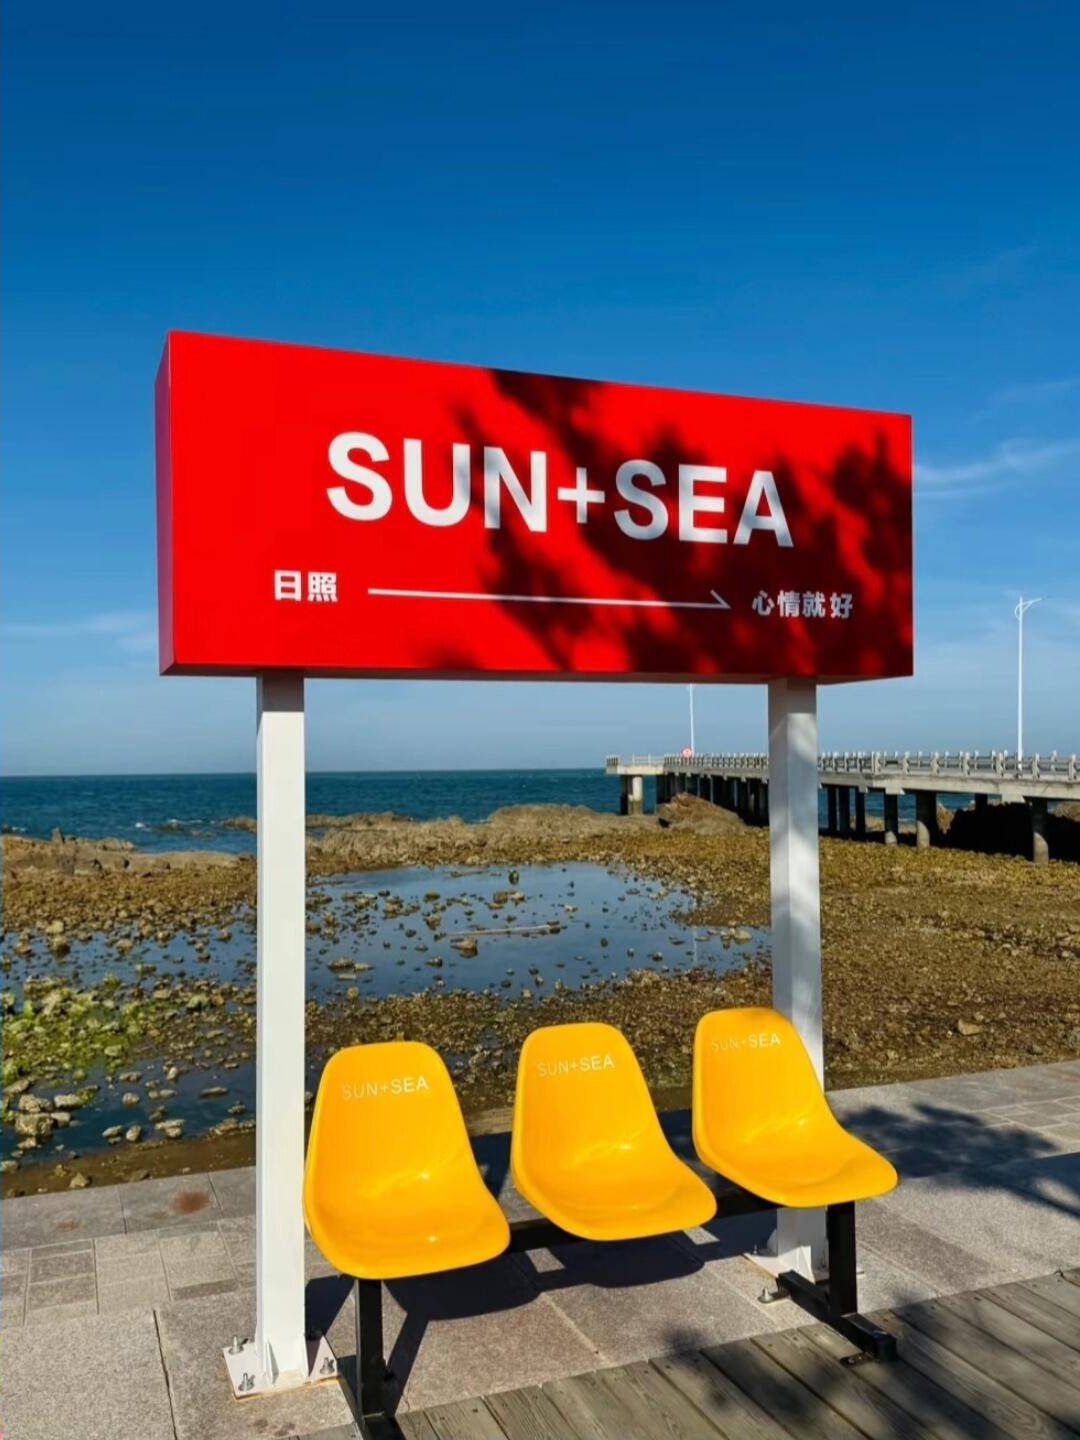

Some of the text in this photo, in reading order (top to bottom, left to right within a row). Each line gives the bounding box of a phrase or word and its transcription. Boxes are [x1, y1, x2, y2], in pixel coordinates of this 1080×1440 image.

[326, 431, 793, 547] SUN+SEA
[274, 569, 853, 618] 日照 心情就好
[711, 1031, 781, 1053] SUN+SEA
[537, 1055, 615, 1077] SUN+SEA
[342, 1076, 429, 1100] SUN+SEA
